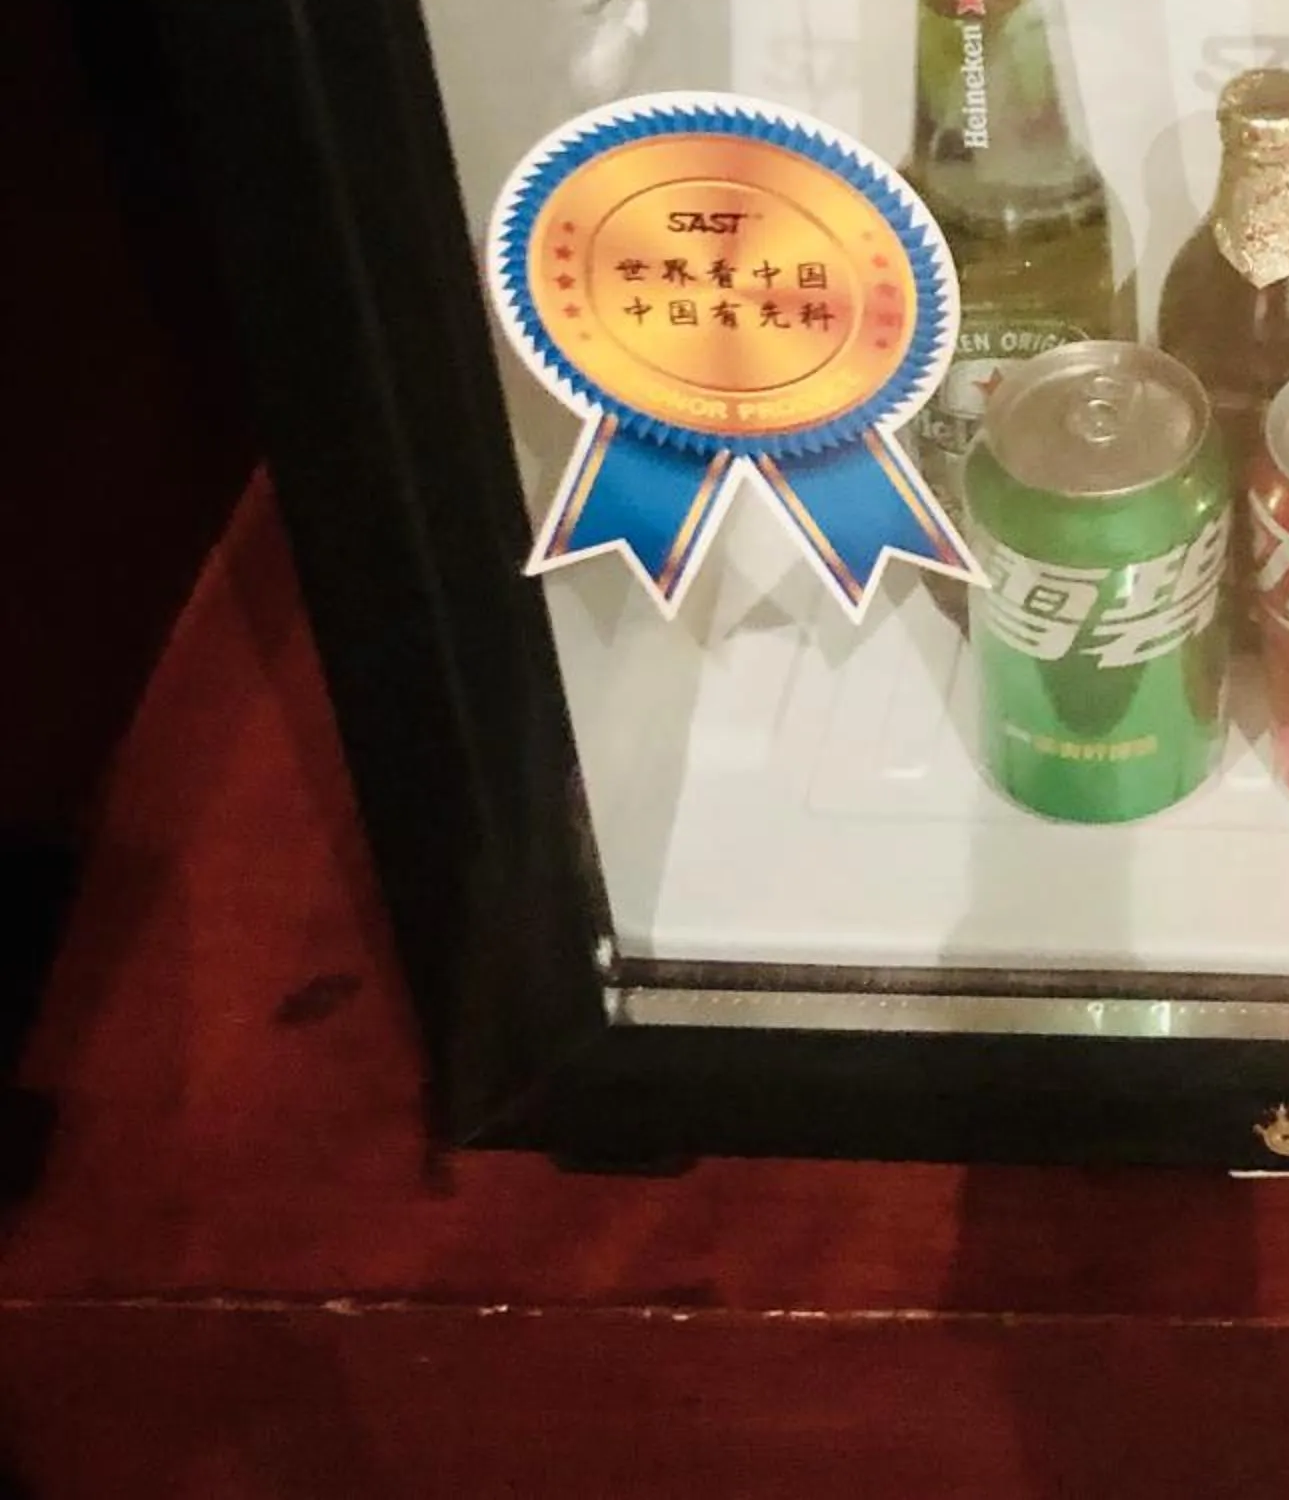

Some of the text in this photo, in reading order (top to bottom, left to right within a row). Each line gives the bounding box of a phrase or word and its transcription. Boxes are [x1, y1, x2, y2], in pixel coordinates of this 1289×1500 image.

[961, 24, 989, 149] Heineken
[667, 212, 748, 234] SAST
[615, 258, 827, 290] 世界看中国
[623, 297, 836, 331] 中国有先科
